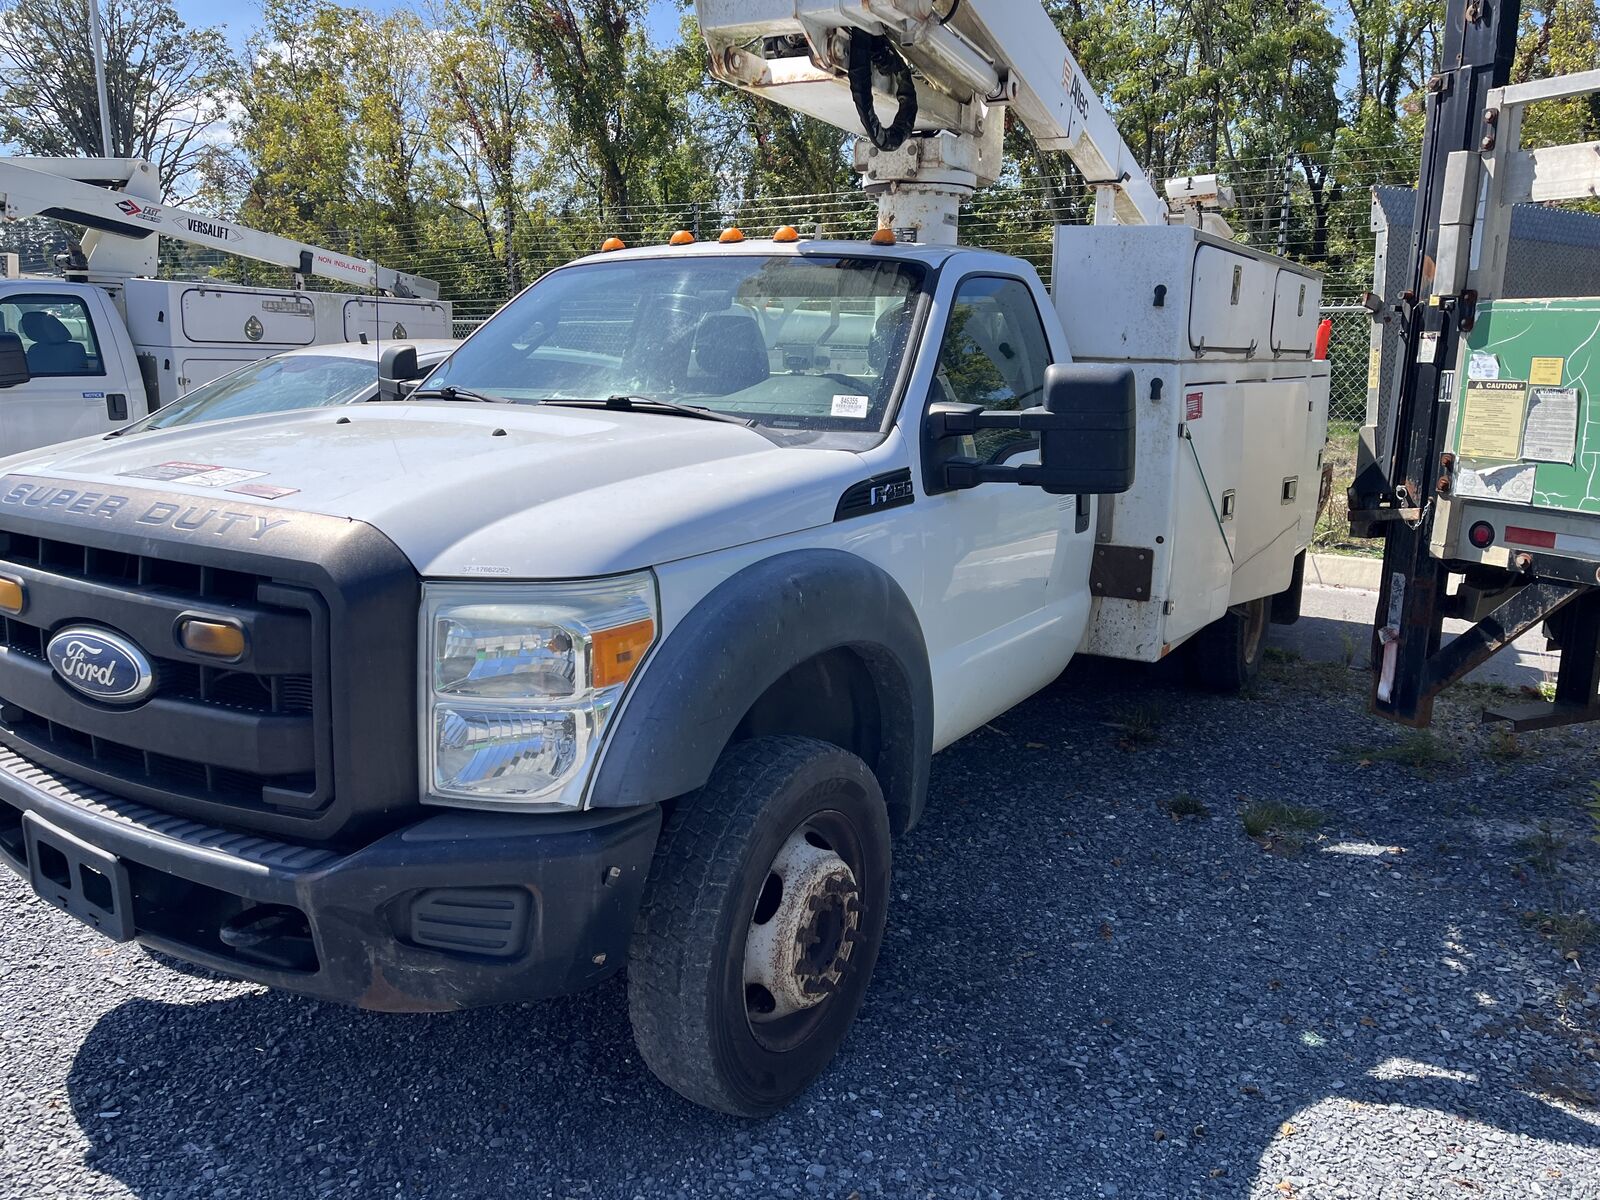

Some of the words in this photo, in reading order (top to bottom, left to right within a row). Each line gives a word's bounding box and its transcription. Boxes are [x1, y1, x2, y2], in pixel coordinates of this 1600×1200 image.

[1069, 73, 1089, 121] Altec
[187, 218, 230, 240] VERSALIFT
[317, 255, 332, 265] NON
[333, 259, 367, 274] INSULATED
[1486, 382, 1518, 390] CAUTION
[1, 483, 131, 519] SUPER
[136, 502, 292, 541] DUTY
[61, 639, 118, 687] Ford
